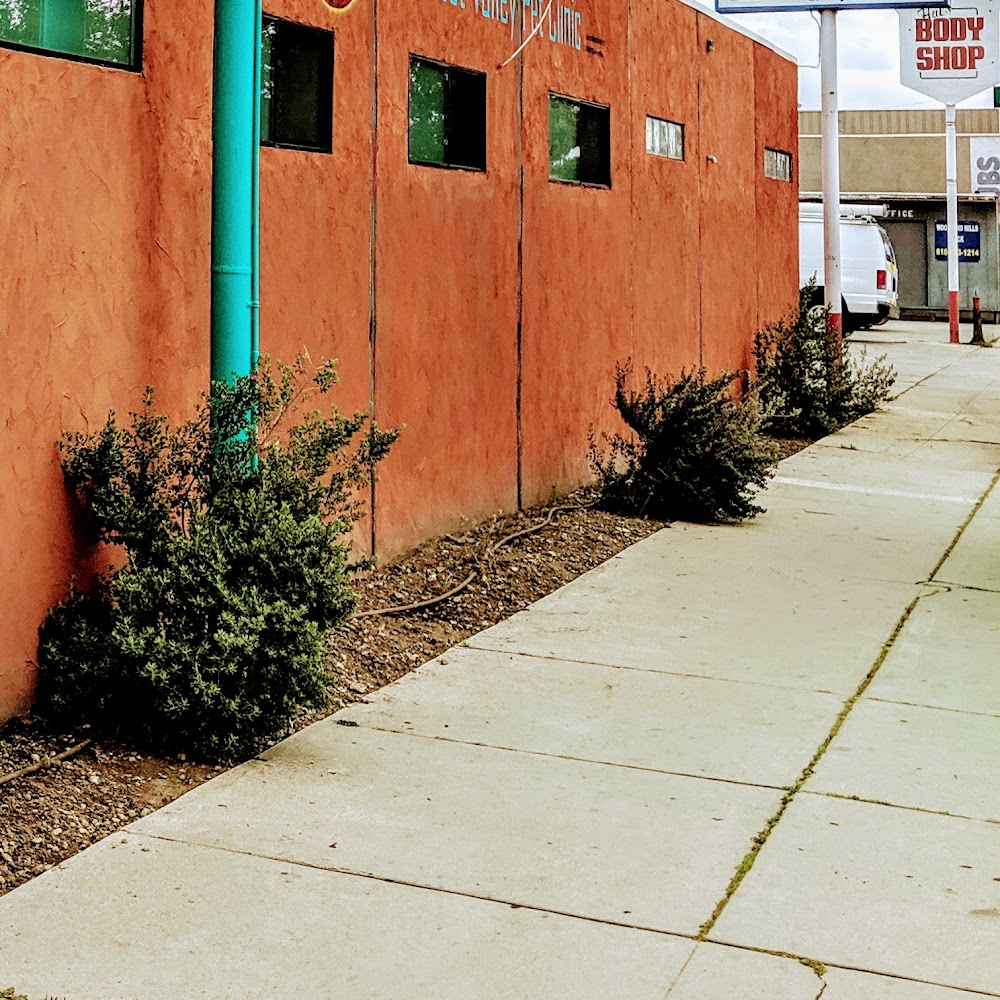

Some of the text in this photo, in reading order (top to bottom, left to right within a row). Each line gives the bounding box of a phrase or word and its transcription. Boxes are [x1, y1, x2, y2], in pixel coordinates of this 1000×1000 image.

[915, 17, 985, 42] BODY
[916, 45, 985, 71] SHOP
[886, 209, 914, 218] FFICE
